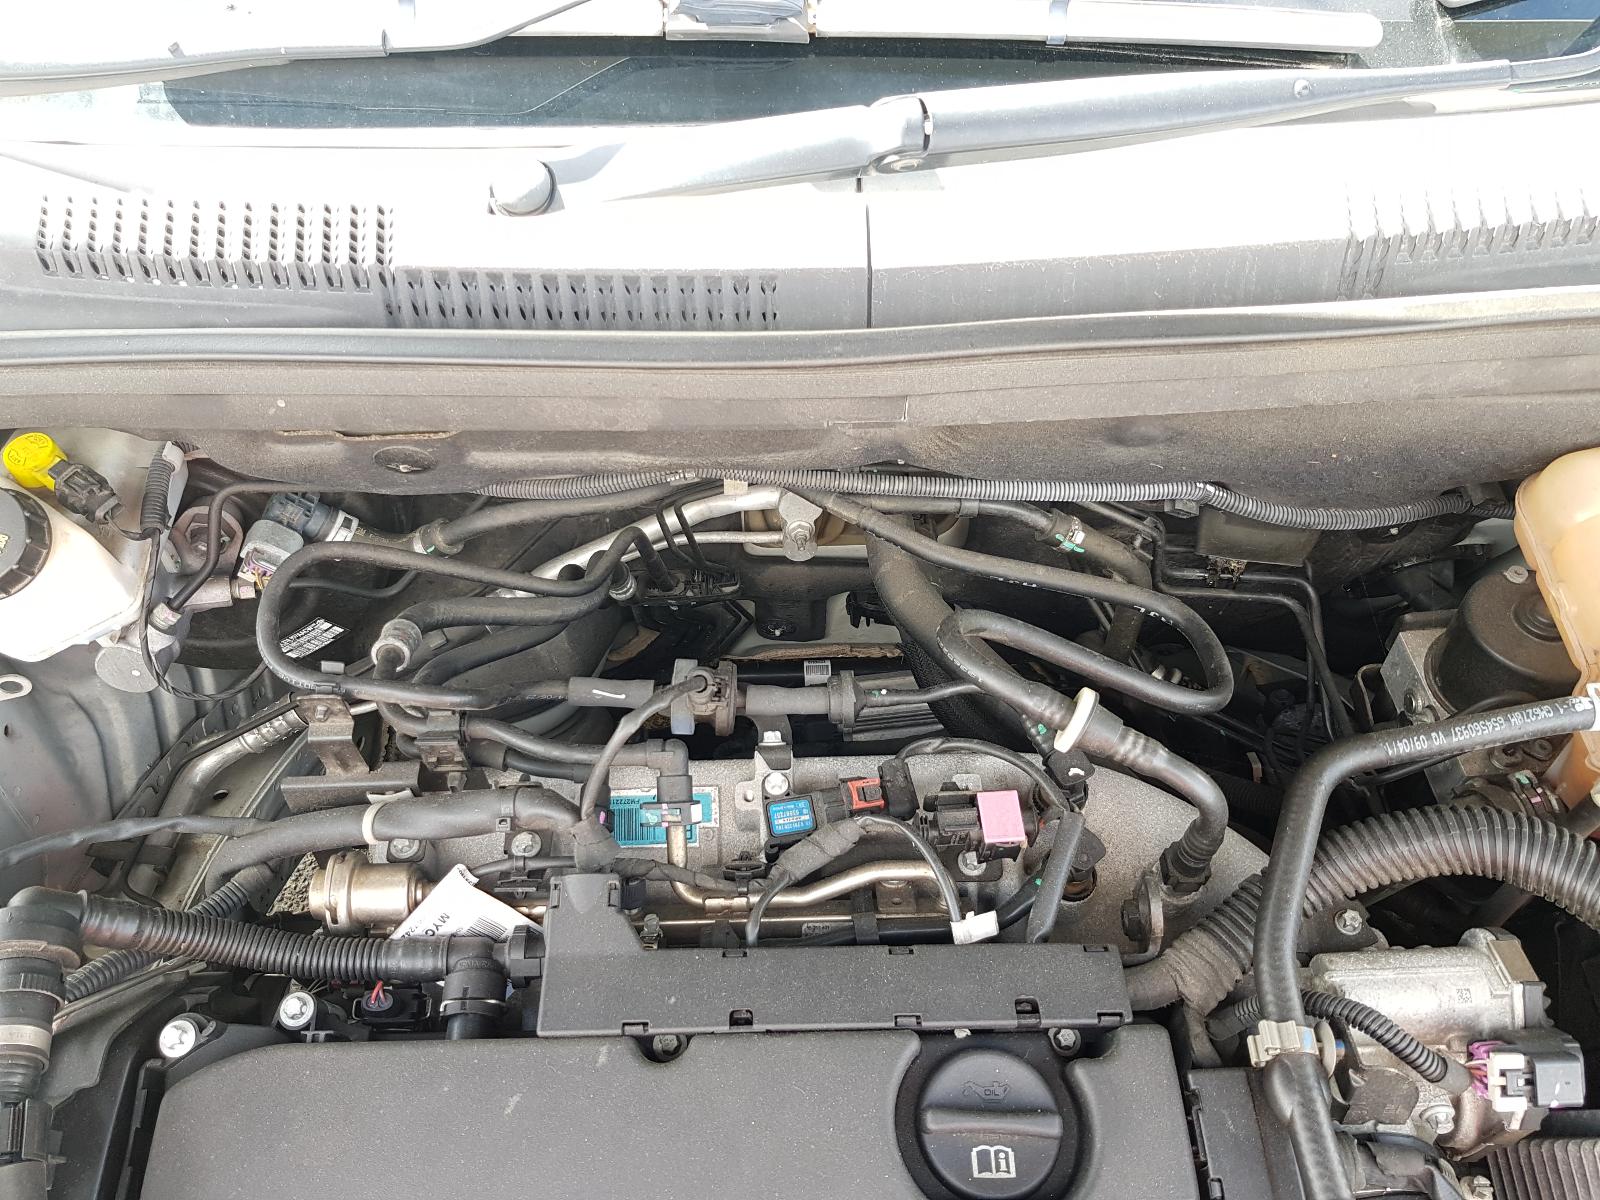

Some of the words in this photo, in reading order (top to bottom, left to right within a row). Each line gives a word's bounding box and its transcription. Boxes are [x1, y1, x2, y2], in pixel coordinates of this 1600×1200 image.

[1509, 707, 1554, 727] GM6278M
[1450, 716, 1505, 742] 654560937
[612, 798, 640, 806] FM27221
[983, 1088, 1000, 1097] OIL
